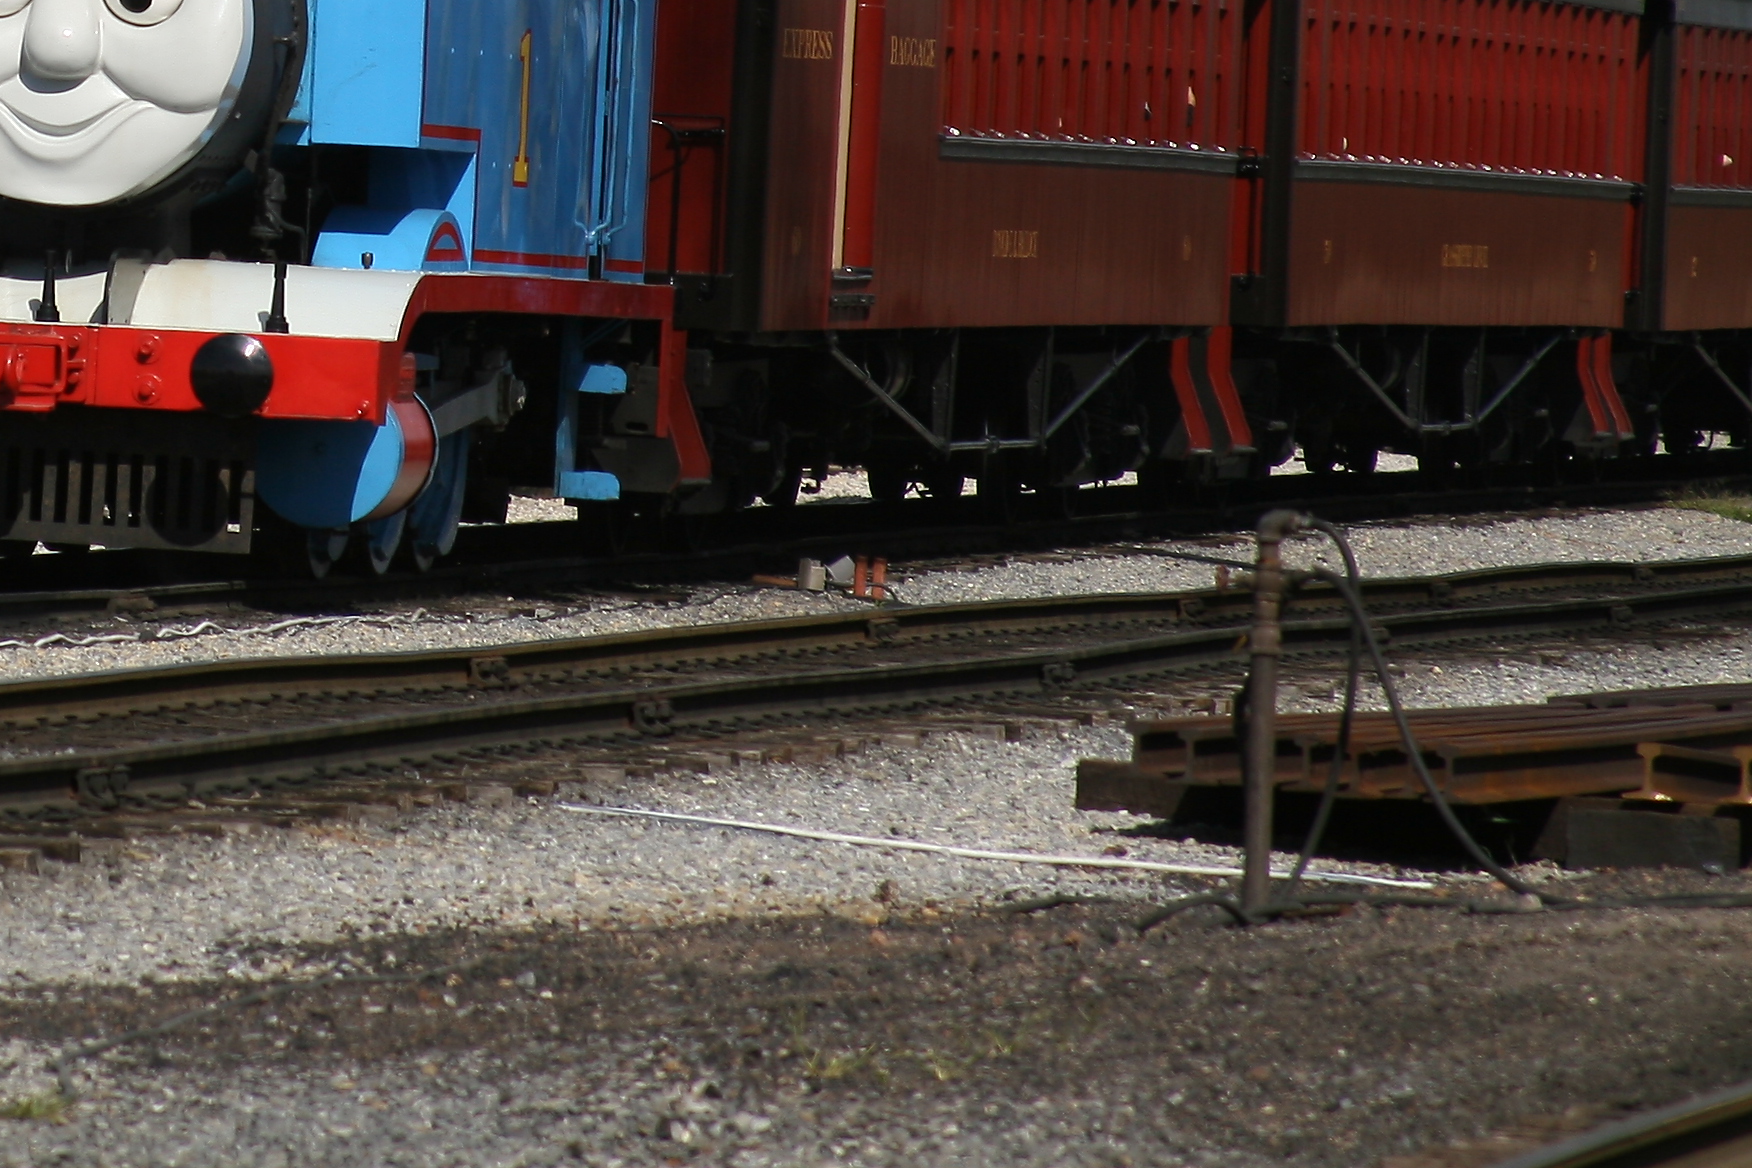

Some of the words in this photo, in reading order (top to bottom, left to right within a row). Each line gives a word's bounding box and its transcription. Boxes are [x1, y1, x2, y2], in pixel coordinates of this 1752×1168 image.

[782, 28, 834, 60] EXPRESS
[890, 35, 936, 68] BAGGAGE
[512, 28, 532, 188] 1
